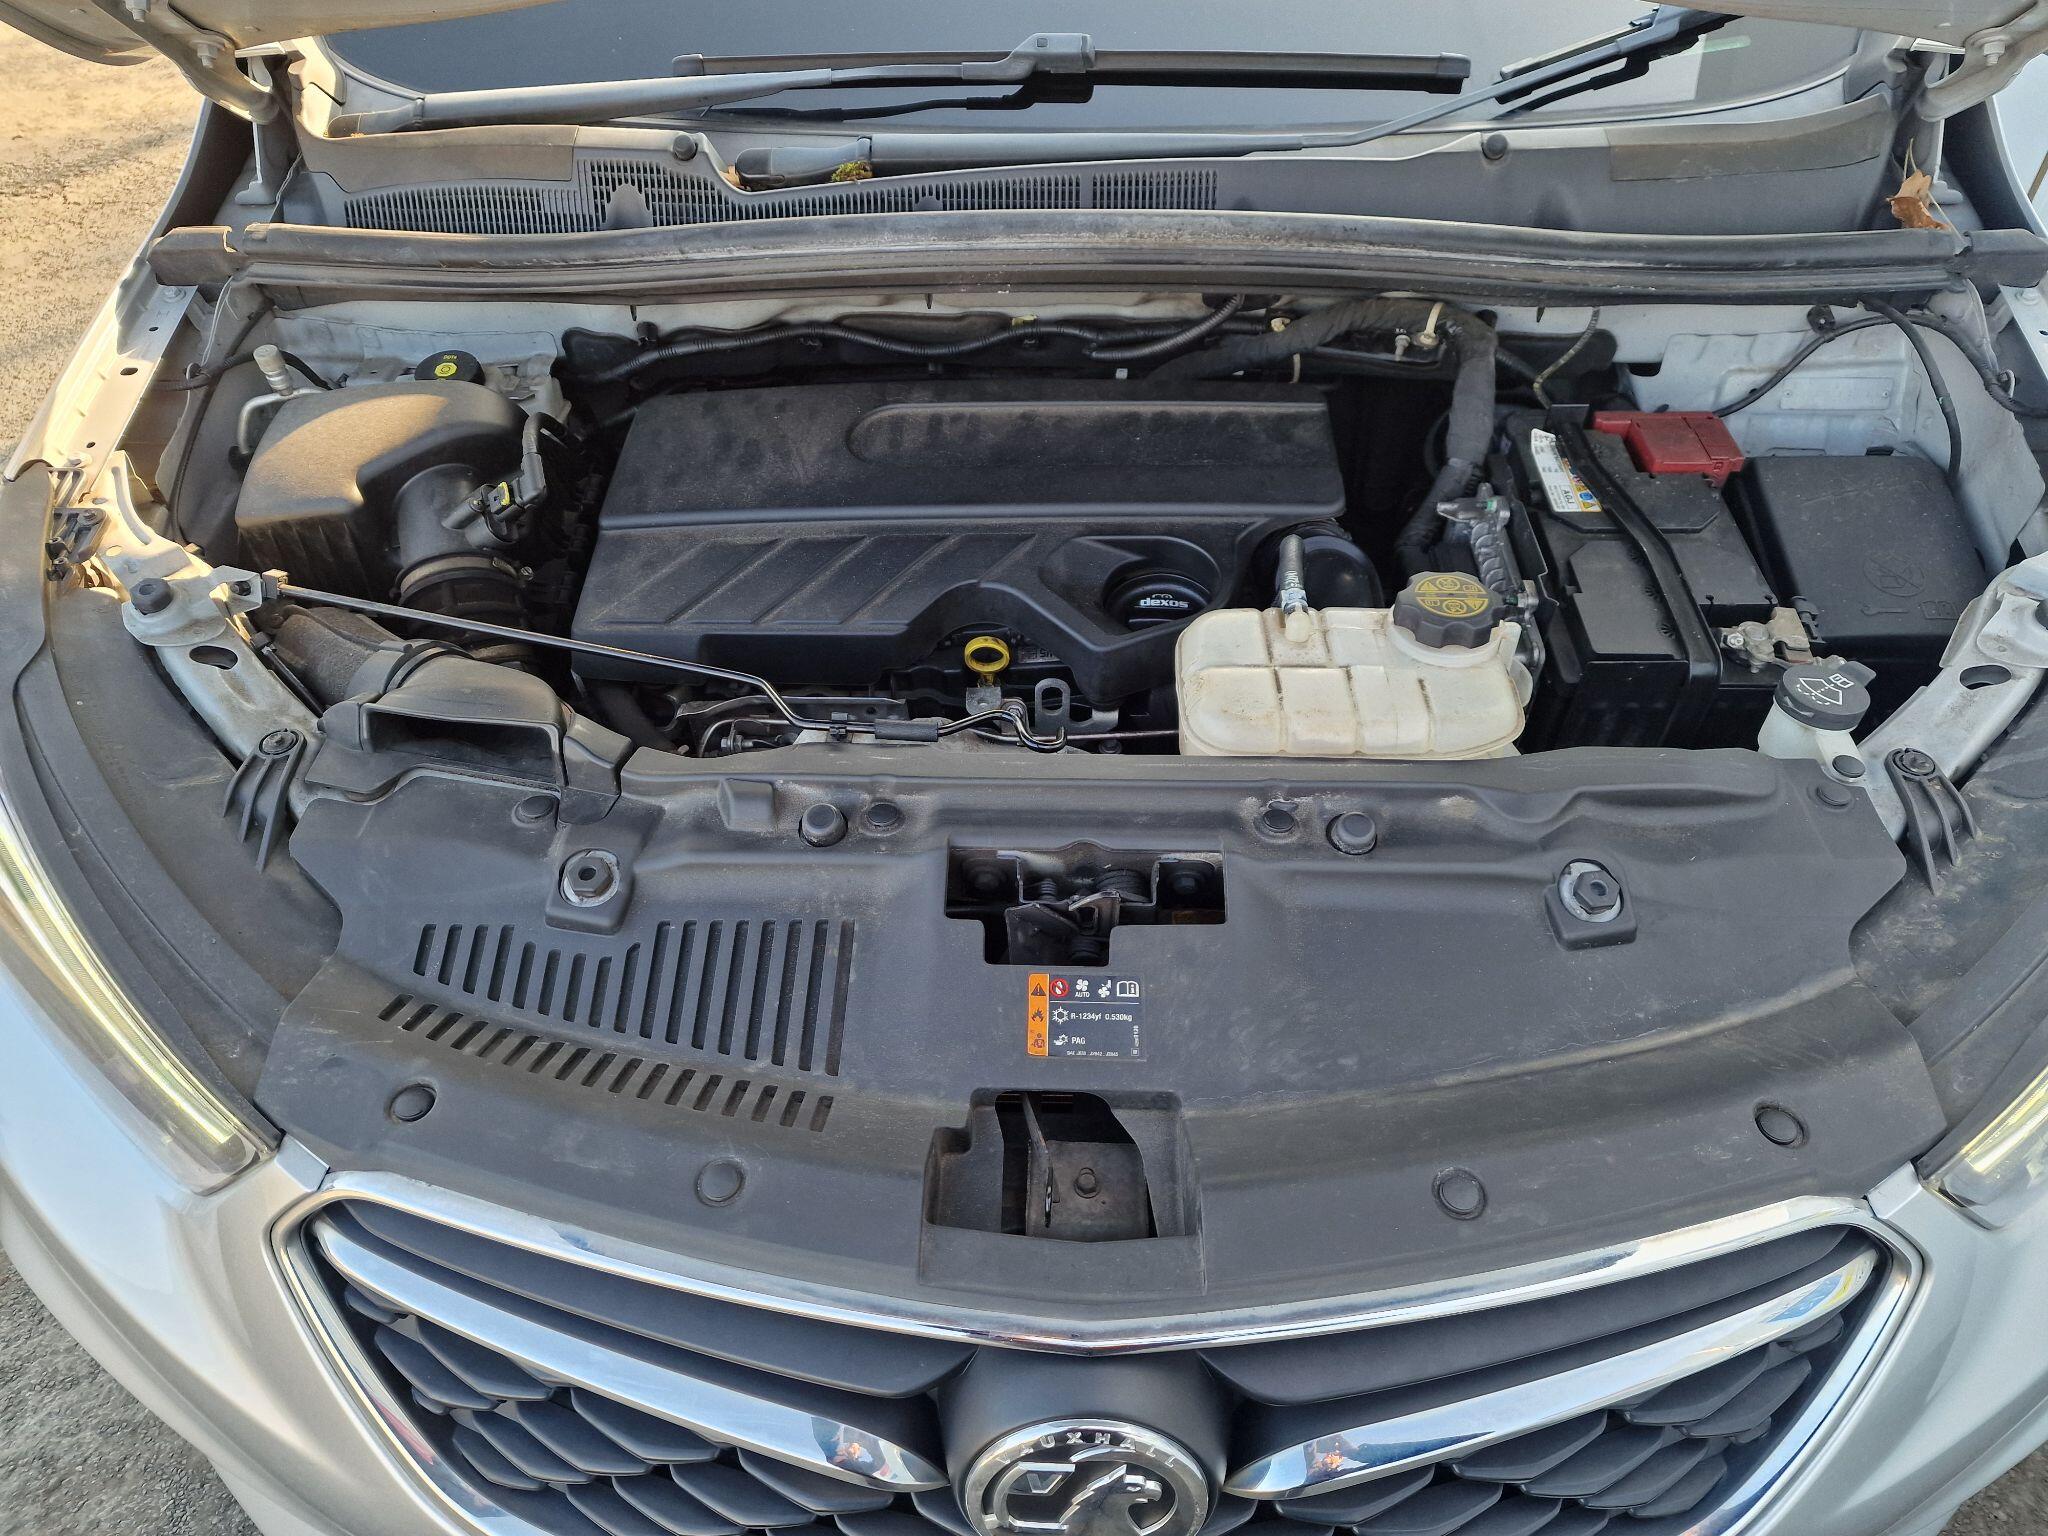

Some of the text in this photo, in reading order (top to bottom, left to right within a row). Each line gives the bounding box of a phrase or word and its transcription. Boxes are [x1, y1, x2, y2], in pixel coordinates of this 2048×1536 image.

[1140, 598, 1189, 608] dexos
[1070, 1012, 1132, 1022] R-1234yf 0.530kg
[1071, 1037, 1086, 1045] PAG
[996, 1431, 1178, 1469] VAUXHALL
